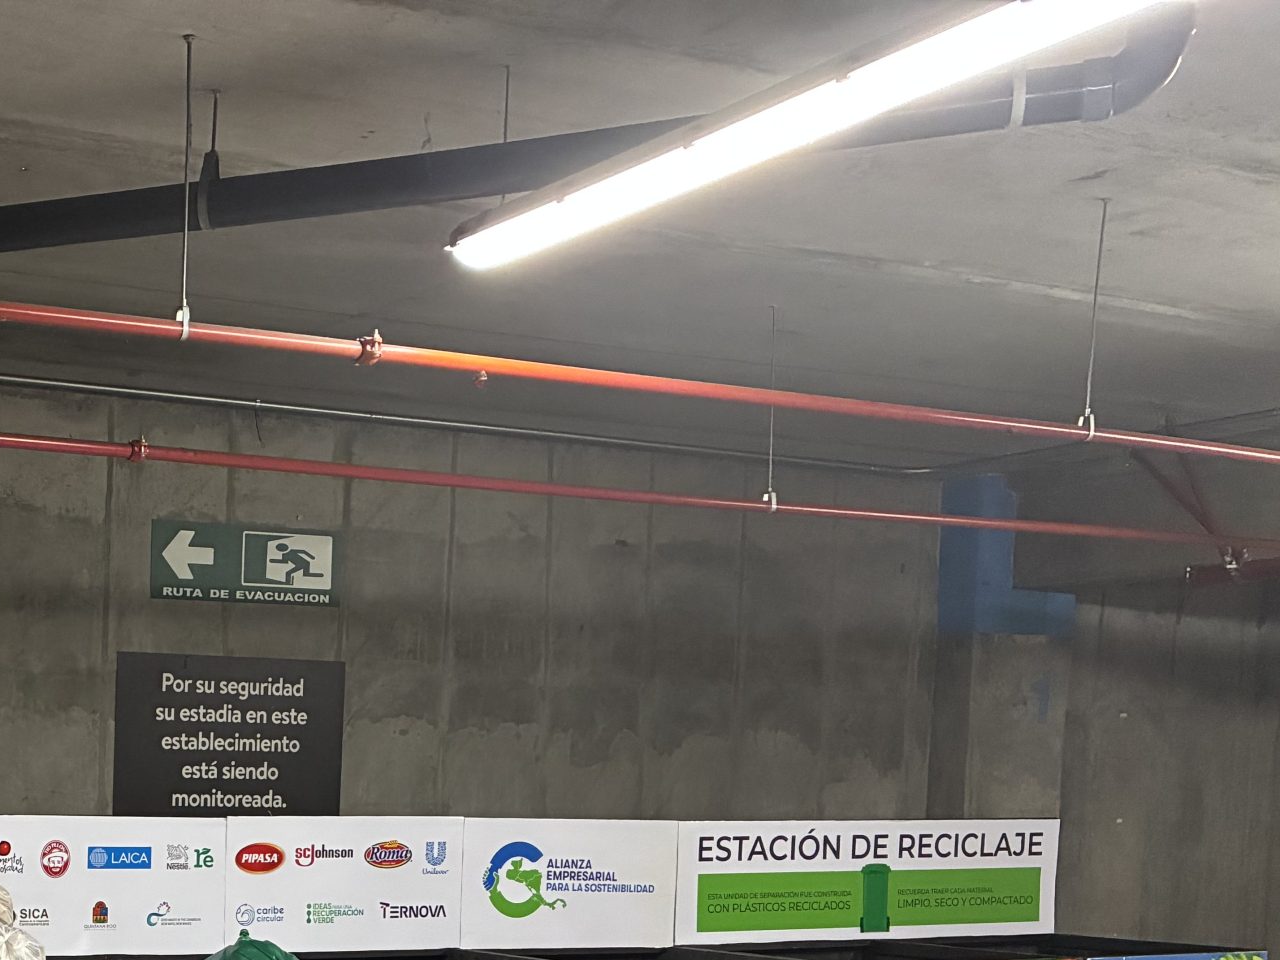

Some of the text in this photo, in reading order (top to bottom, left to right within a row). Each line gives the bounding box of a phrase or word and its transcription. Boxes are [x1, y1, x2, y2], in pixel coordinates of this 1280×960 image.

[163, 587, 329, 603] RUTA DE EVACUACION
[162, 672, 304, 700] Por su seguridad
[155, 705, 307, 724] su estadia en este
[161, 732, 300, 752] establecimiento
[182, 761, 278, 780] está siendo
[172, 789, 287, 808] monitoreada.
[698, 829, 1044, 861] ESTACIÓN DE RECICLAJE
[112, 852, 149, 864] LAICA
[194, 848, 214, 868] re
[241, 853, 279, 864] PIPASA
[369, 845, 411, 860] Roma
[547, 859, 592, 870] ALIANZA
[547, 871, 617, 882] EMPRESARIAL
[546, 883, 655, 893] PARA LA SOSTENIBILIDAD
[708, 899, 851, 913] CON PLÁSTICOS RECICLADOS
[934, 897, 959, 908] SECO
[960, 898, 968, 907] Y
[968, 895, 1034, 907] COMPACTADO
[19, 908, 49, 919] SICA
[256, 907, 284, 915] caribe
[312, 908, 364, 917] RECUPERACIÓN
[379, 902, 446, 919] TERNOVA
